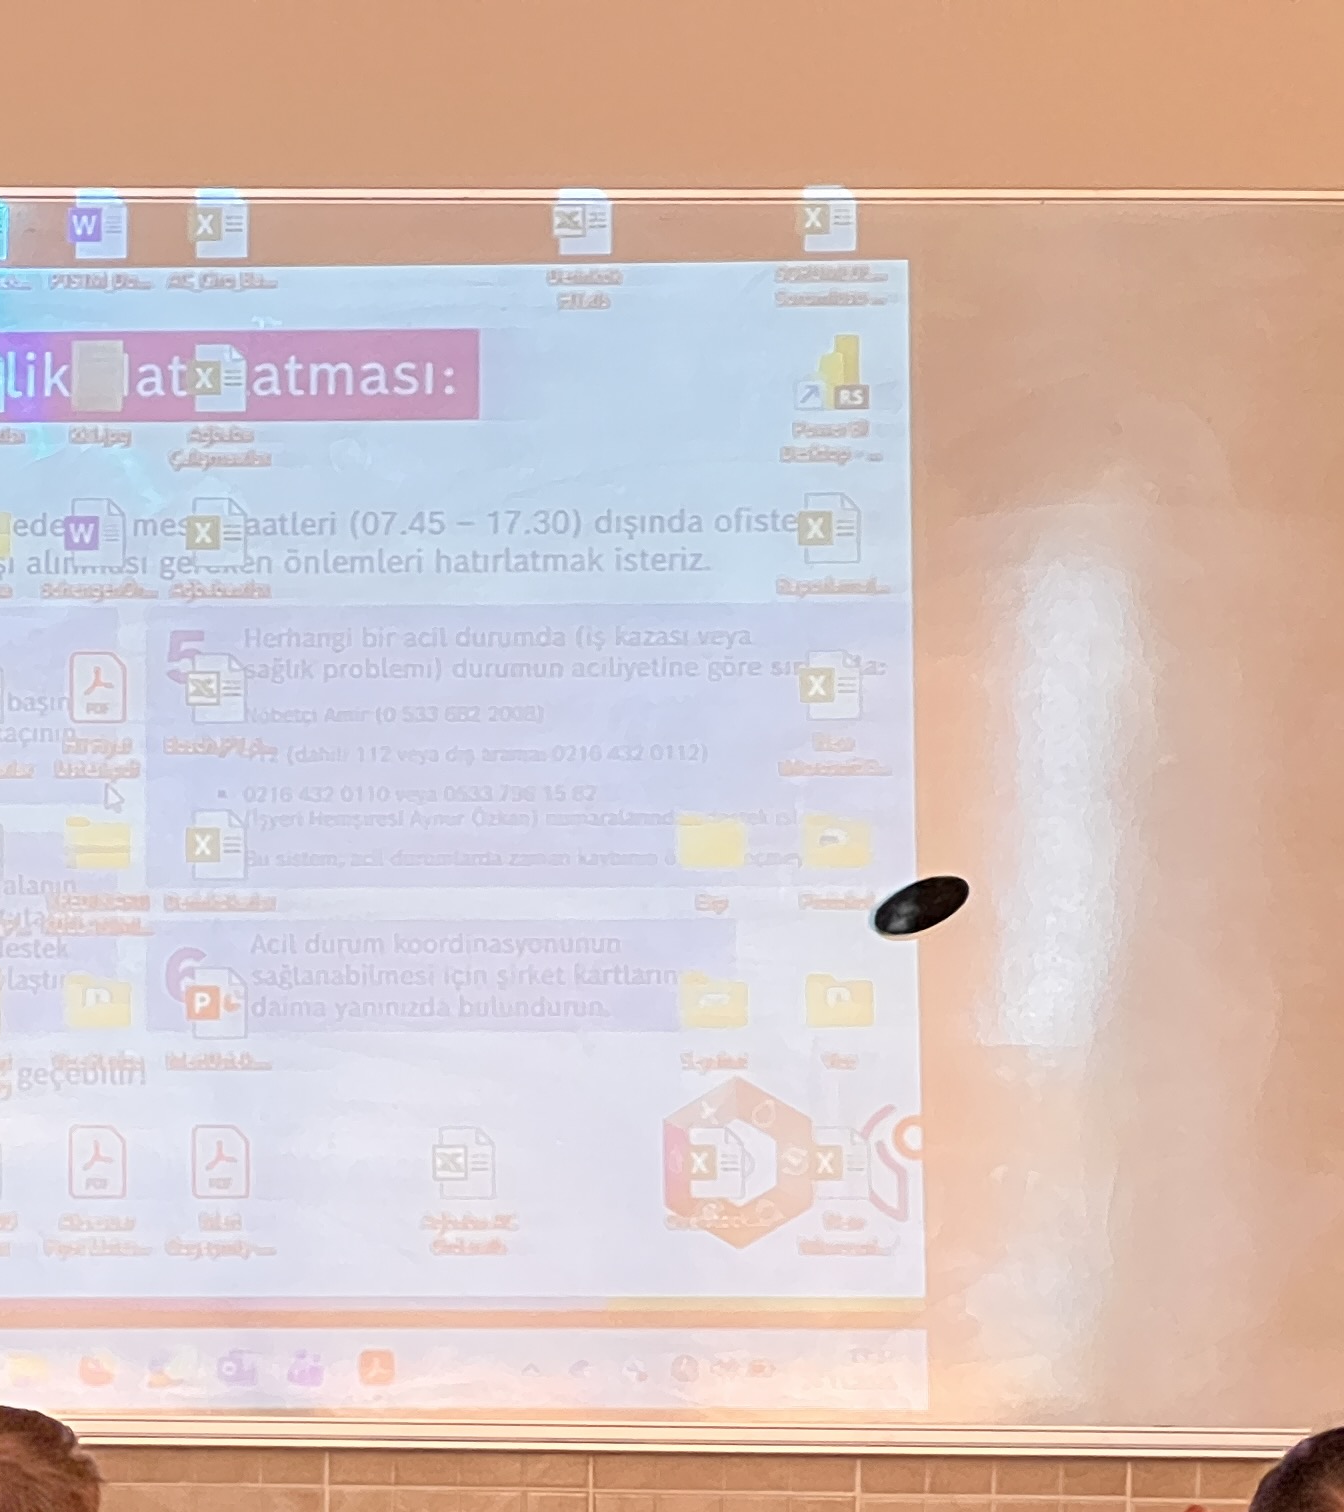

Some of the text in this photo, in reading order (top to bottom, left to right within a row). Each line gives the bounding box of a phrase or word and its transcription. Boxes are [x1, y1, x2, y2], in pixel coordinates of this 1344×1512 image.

[246, 510, 337, 537] aatleri
[349, 508, 447, 541] (07.45
[487, 508, 582, 540] 17.30)
[593, 507, 704, 541] dışında
[713, 506, 799, 535] ofiste
[283, 547, 424, 574] önlemleri
[434, 547, 604, 574] hatırlatmak
[614, 545, 712, 573] isteriz.
[244, 627, 352, 653] Herhangi
[362, 626, 399, 648] bir
[402, 626, 448, 648] acil
[455, 625, 566, 647] durumda
[615, 624, 689, 647] kazası
[698, 630, 752, 650] veya
[452, 657, 564, 679] durumun
[571, 656, 699, 682] aciliyetine
[707, 657, 762, 683] göre
[250, 932, 622, 959] Acil durum koordinasyonunun
[250, 962, 678, 992] sağlanabilmesi için şirket kartların
[250, 997, 327, 1018] daima
[335, 996, 452, 1022] yanınızda
